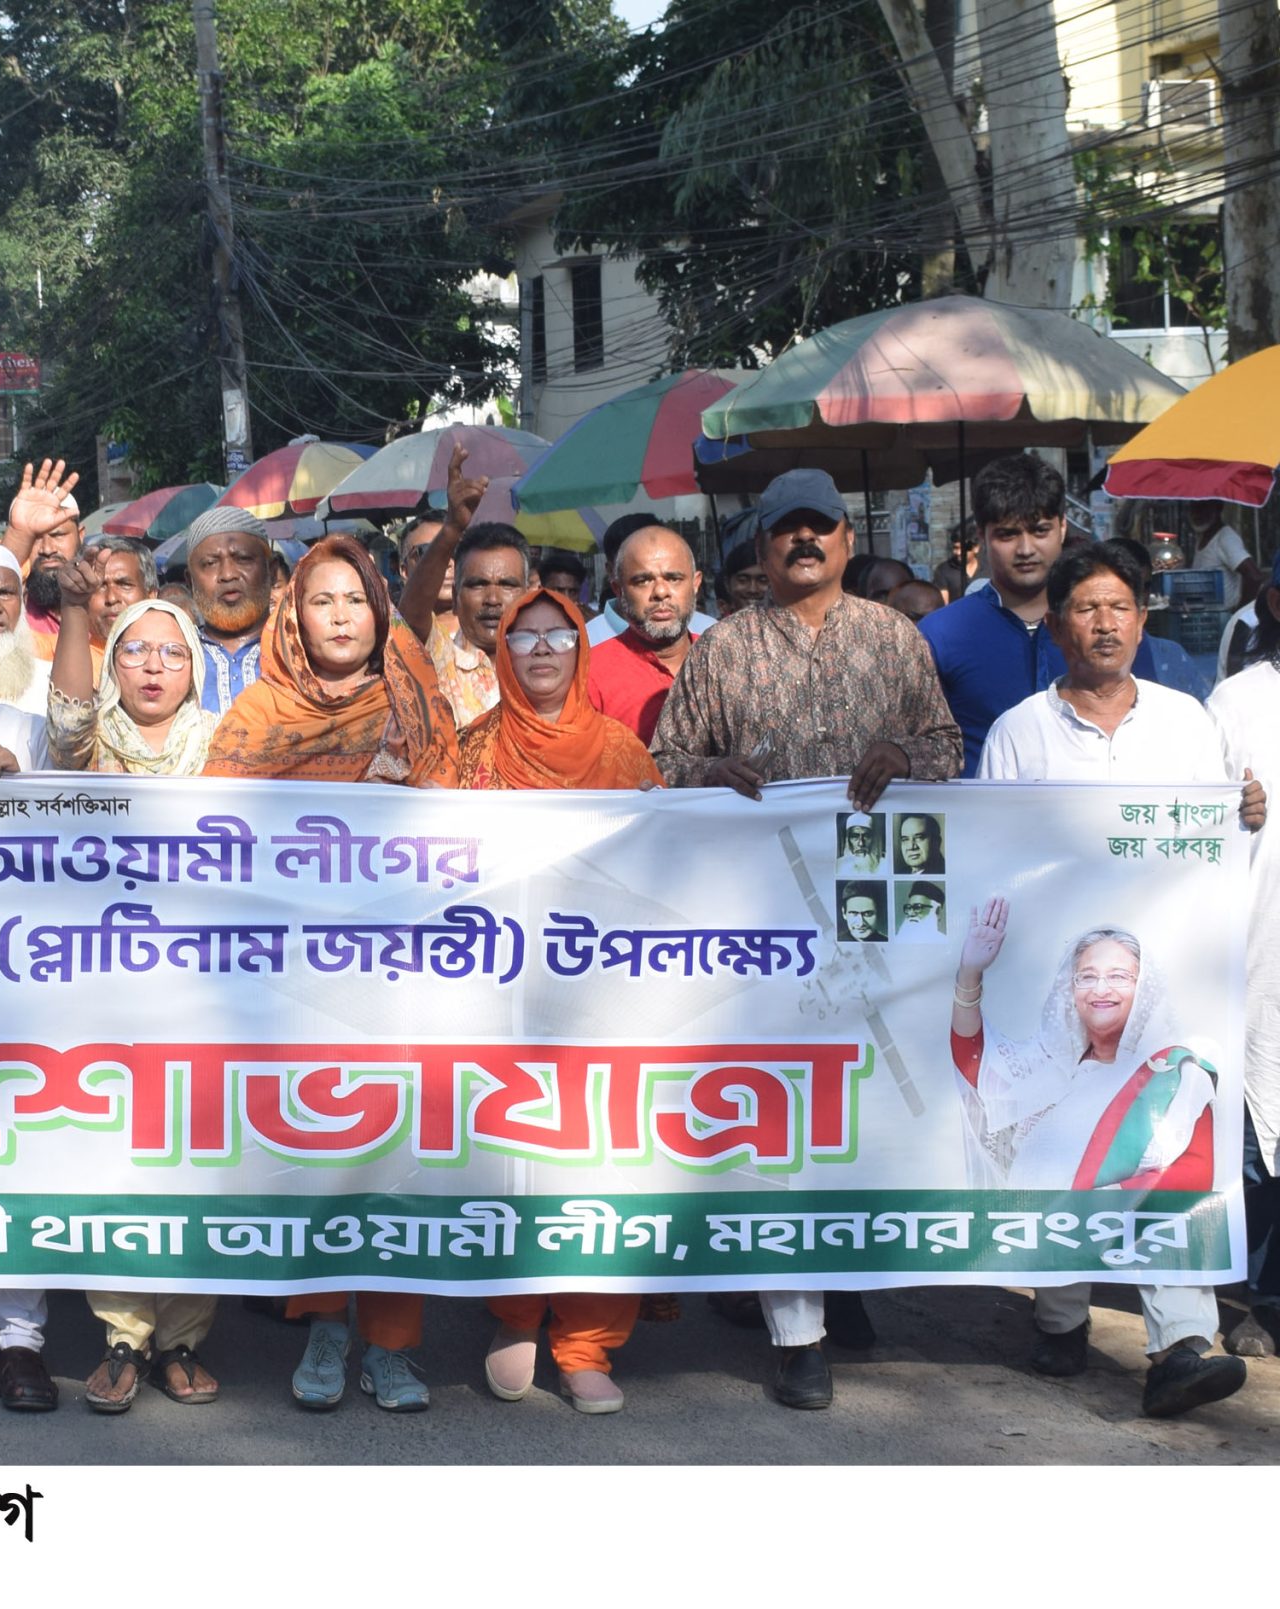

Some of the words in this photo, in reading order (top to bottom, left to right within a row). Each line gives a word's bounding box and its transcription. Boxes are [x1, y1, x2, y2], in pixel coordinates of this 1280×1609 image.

[35, 793, 131, 816] সর্বশক্তিমান
[1119, 804, 1159, 824] জয়
[1166, 802, 1228, 827] বাংলা
[272, 815, 482, 889] লীগের
[1107, 837, 1147, 858] জয়
[1154, 837, 1224, 865] বঙ্গবন্ধু
[306, 905, 526, 984] জয়ন্তী)
[543, 912, 817, 976] উপলক্ষ্যে
[31, 1214, 189, 1255] থানা
[202, 1202, 518, 1265] আওয়ামী
[535, 1200, 688, 1261] লীগ,
[705, 1209, 974, 1256] মহানগর
[987, 1208, 1192, 1265] রংপুর
